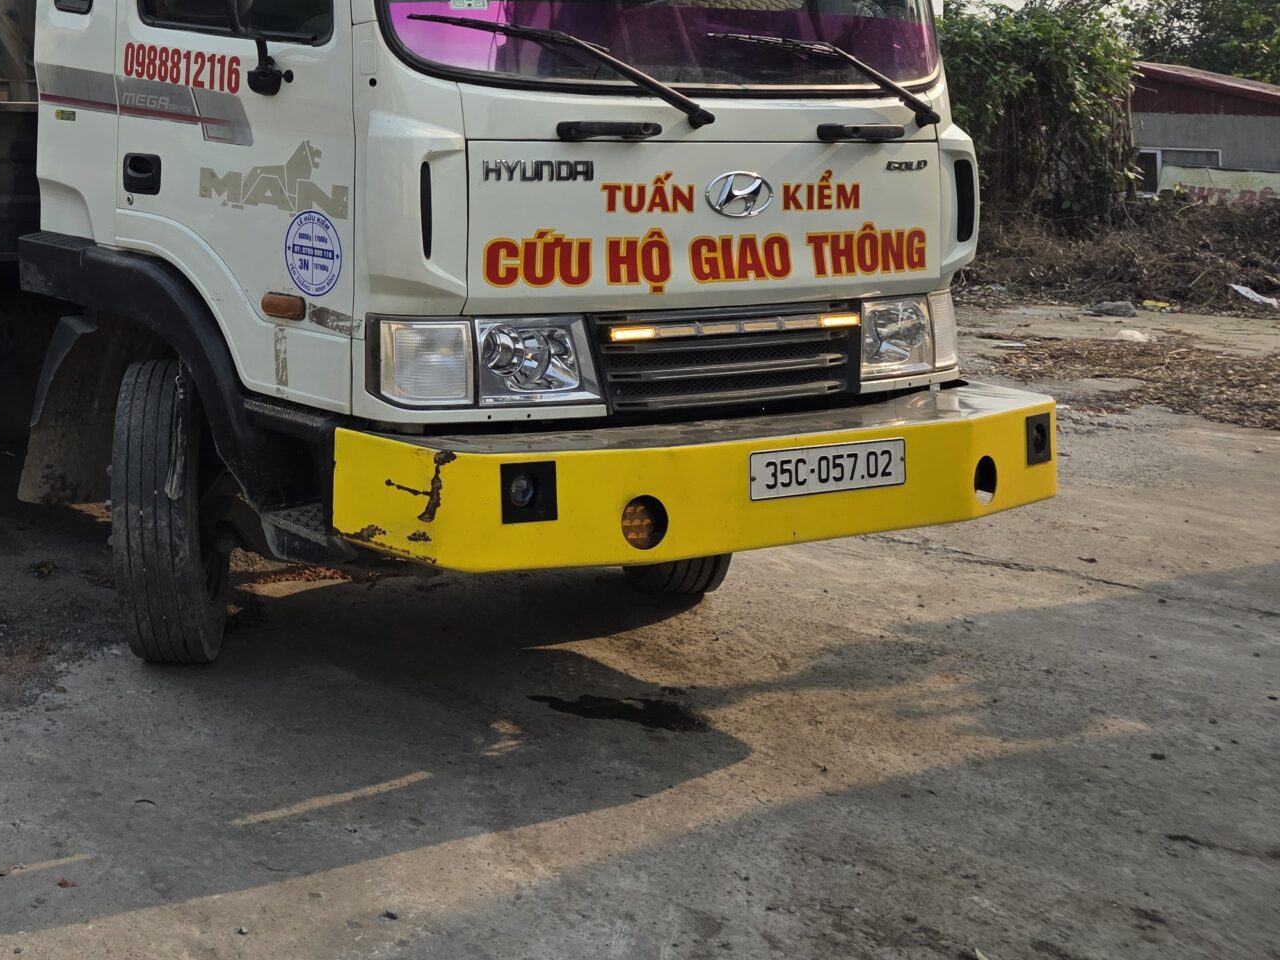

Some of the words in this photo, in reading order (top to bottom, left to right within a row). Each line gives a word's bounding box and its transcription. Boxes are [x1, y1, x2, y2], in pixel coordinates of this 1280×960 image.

[123, 42, 241, 94] 0988812116
[122, 92, 170, 110] MEGA
[169, 103, 192, 113] TRUCK
[483, 159, 594, 182] HYUNDAI
[885, 159, 928, 171] GOLD
[199, 166, 350, 220] MAN
[600, 170, 695, 214] TUẤN
[782, 169, 861, 211] KIỂM
[298, 258, 309, 272] 3N
[483, 229, 593, 288] CỨU
[606, 227, 672, 295] HỘ
[688, 233, 793, 284] GIAO
[805, 221, 928, 279] THÔNG
[765, 449, 893, 490] 35C-057.02
